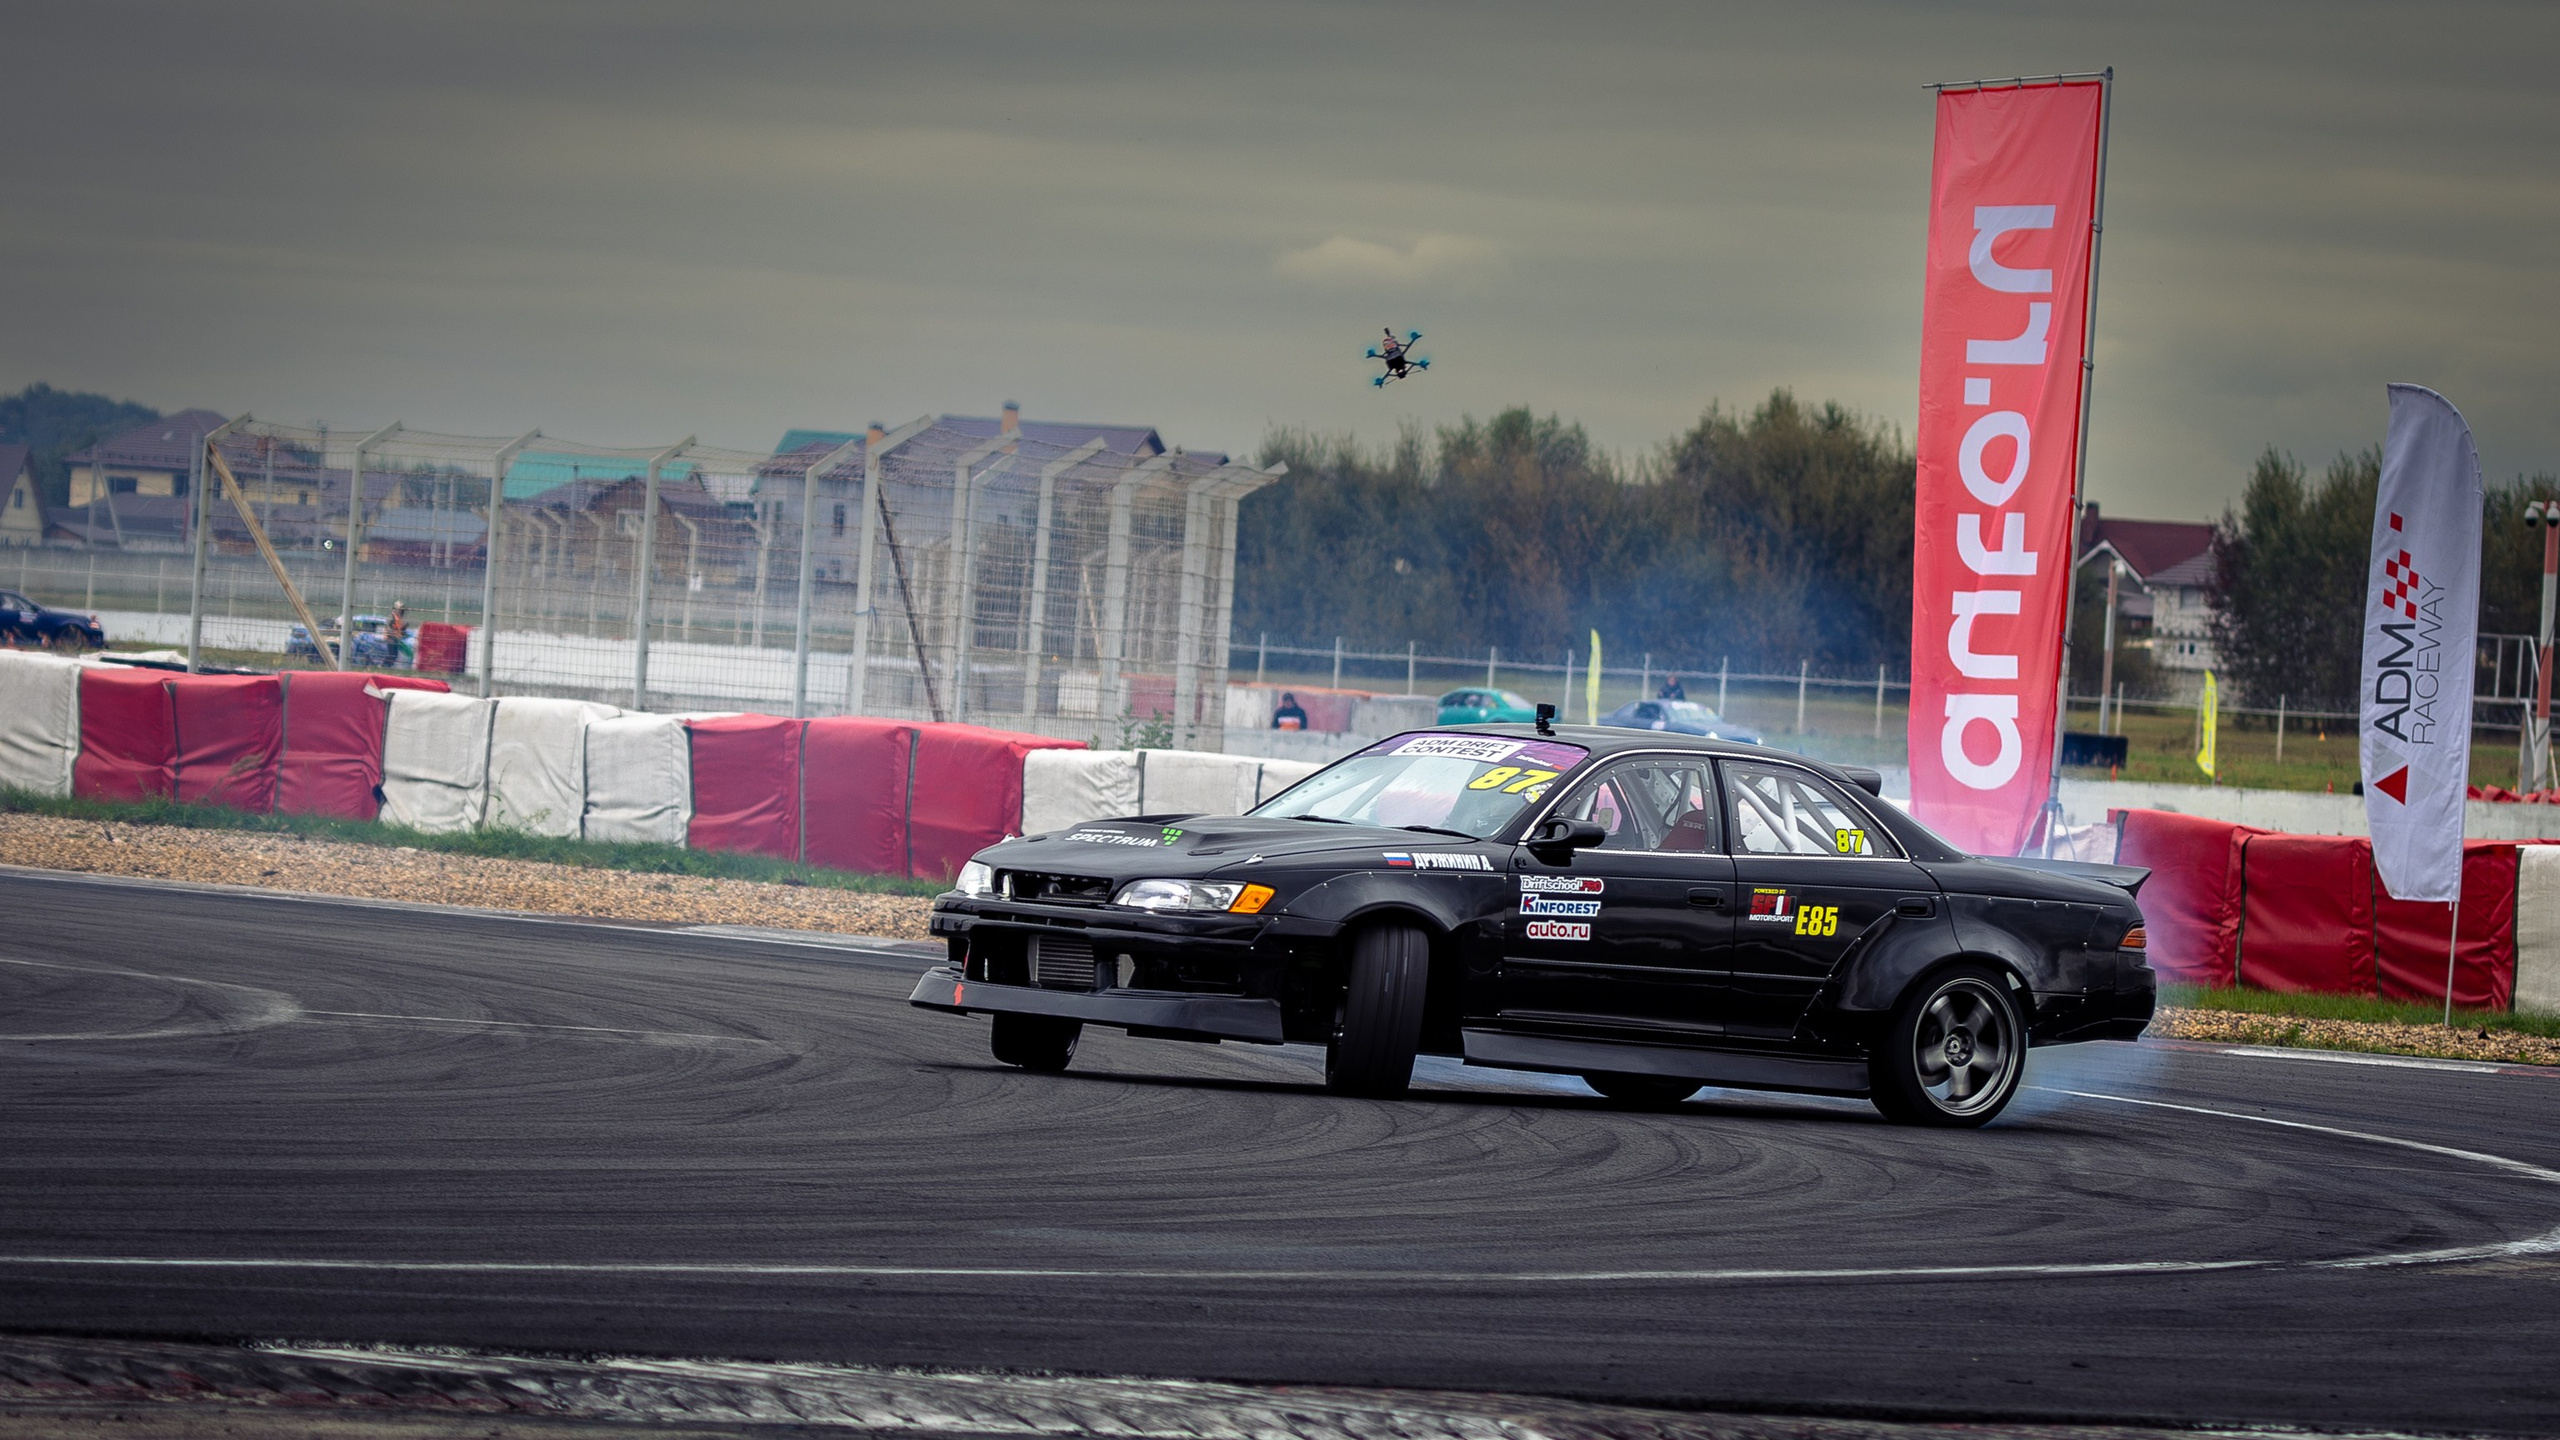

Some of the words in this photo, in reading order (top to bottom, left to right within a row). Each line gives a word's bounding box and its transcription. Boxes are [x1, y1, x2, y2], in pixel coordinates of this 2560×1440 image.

[2411, 576, 2445, 744] RACEWAY
[2374, 623, 2416, 743] ADM
[1401, 746, 1503, 758] CONTEST
[1414, 739, 1455, 748] ADM
[1456, 741, 1516, 751] DRIFT
[1467, 766, 1559, 793] 87
[1065, 833, 1158, 847] SPECTRUM
[1835, 828, 1865, 853] 87
[1749, 914, 1794, 922] MOTORSPORT
[1795, 905, 1838, 936] E85
[1528, 922, 1588, 938] auto.ru
